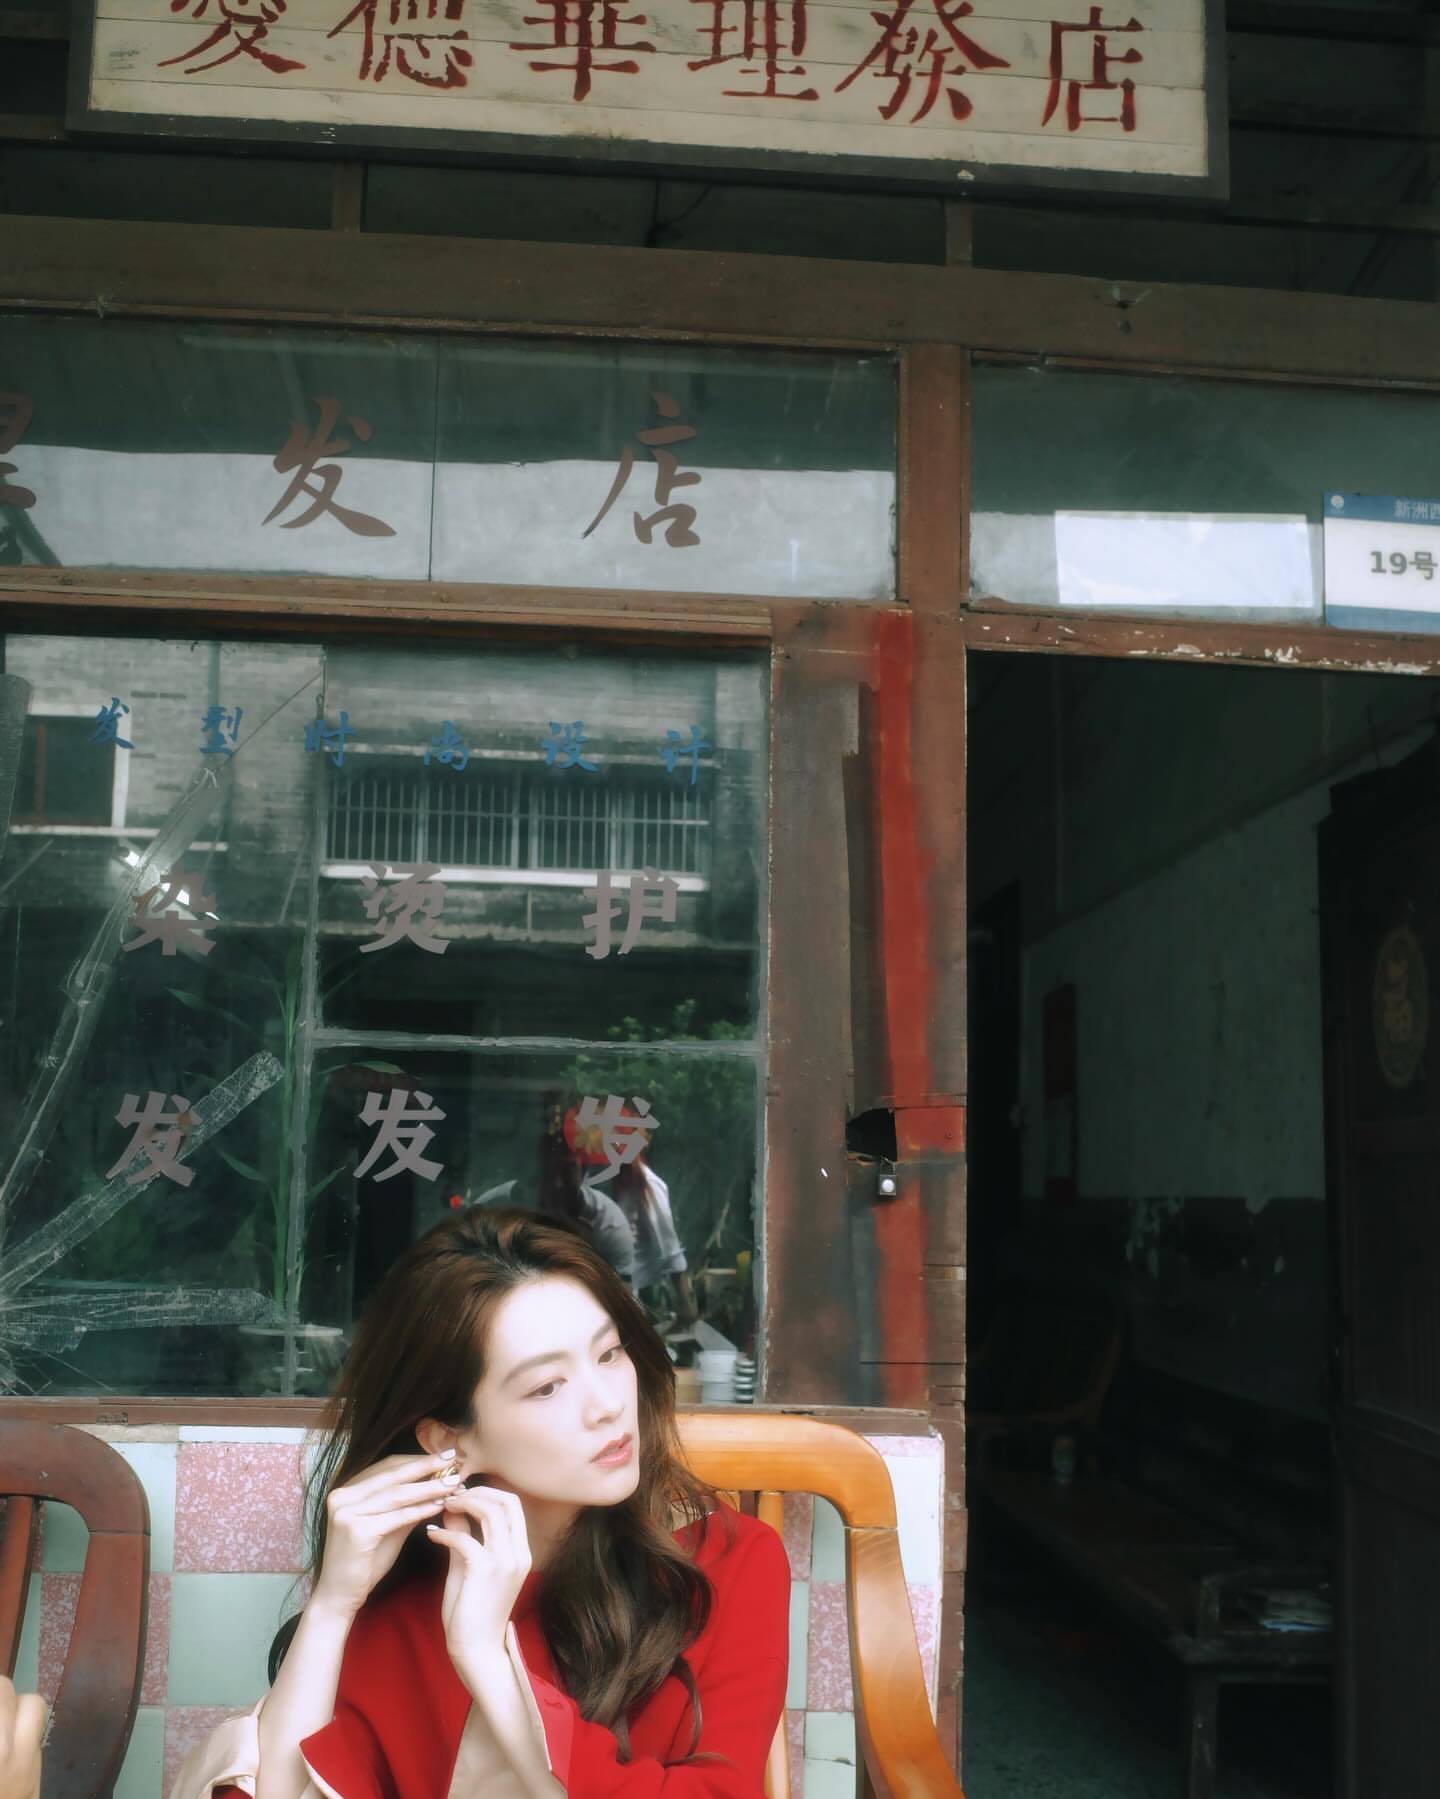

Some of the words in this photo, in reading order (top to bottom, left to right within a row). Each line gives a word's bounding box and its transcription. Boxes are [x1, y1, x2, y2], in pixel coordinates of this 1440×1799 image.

[1370, 551, 1438, 581] 19号
[88, 697, 711, 785] 发型时尚设计
